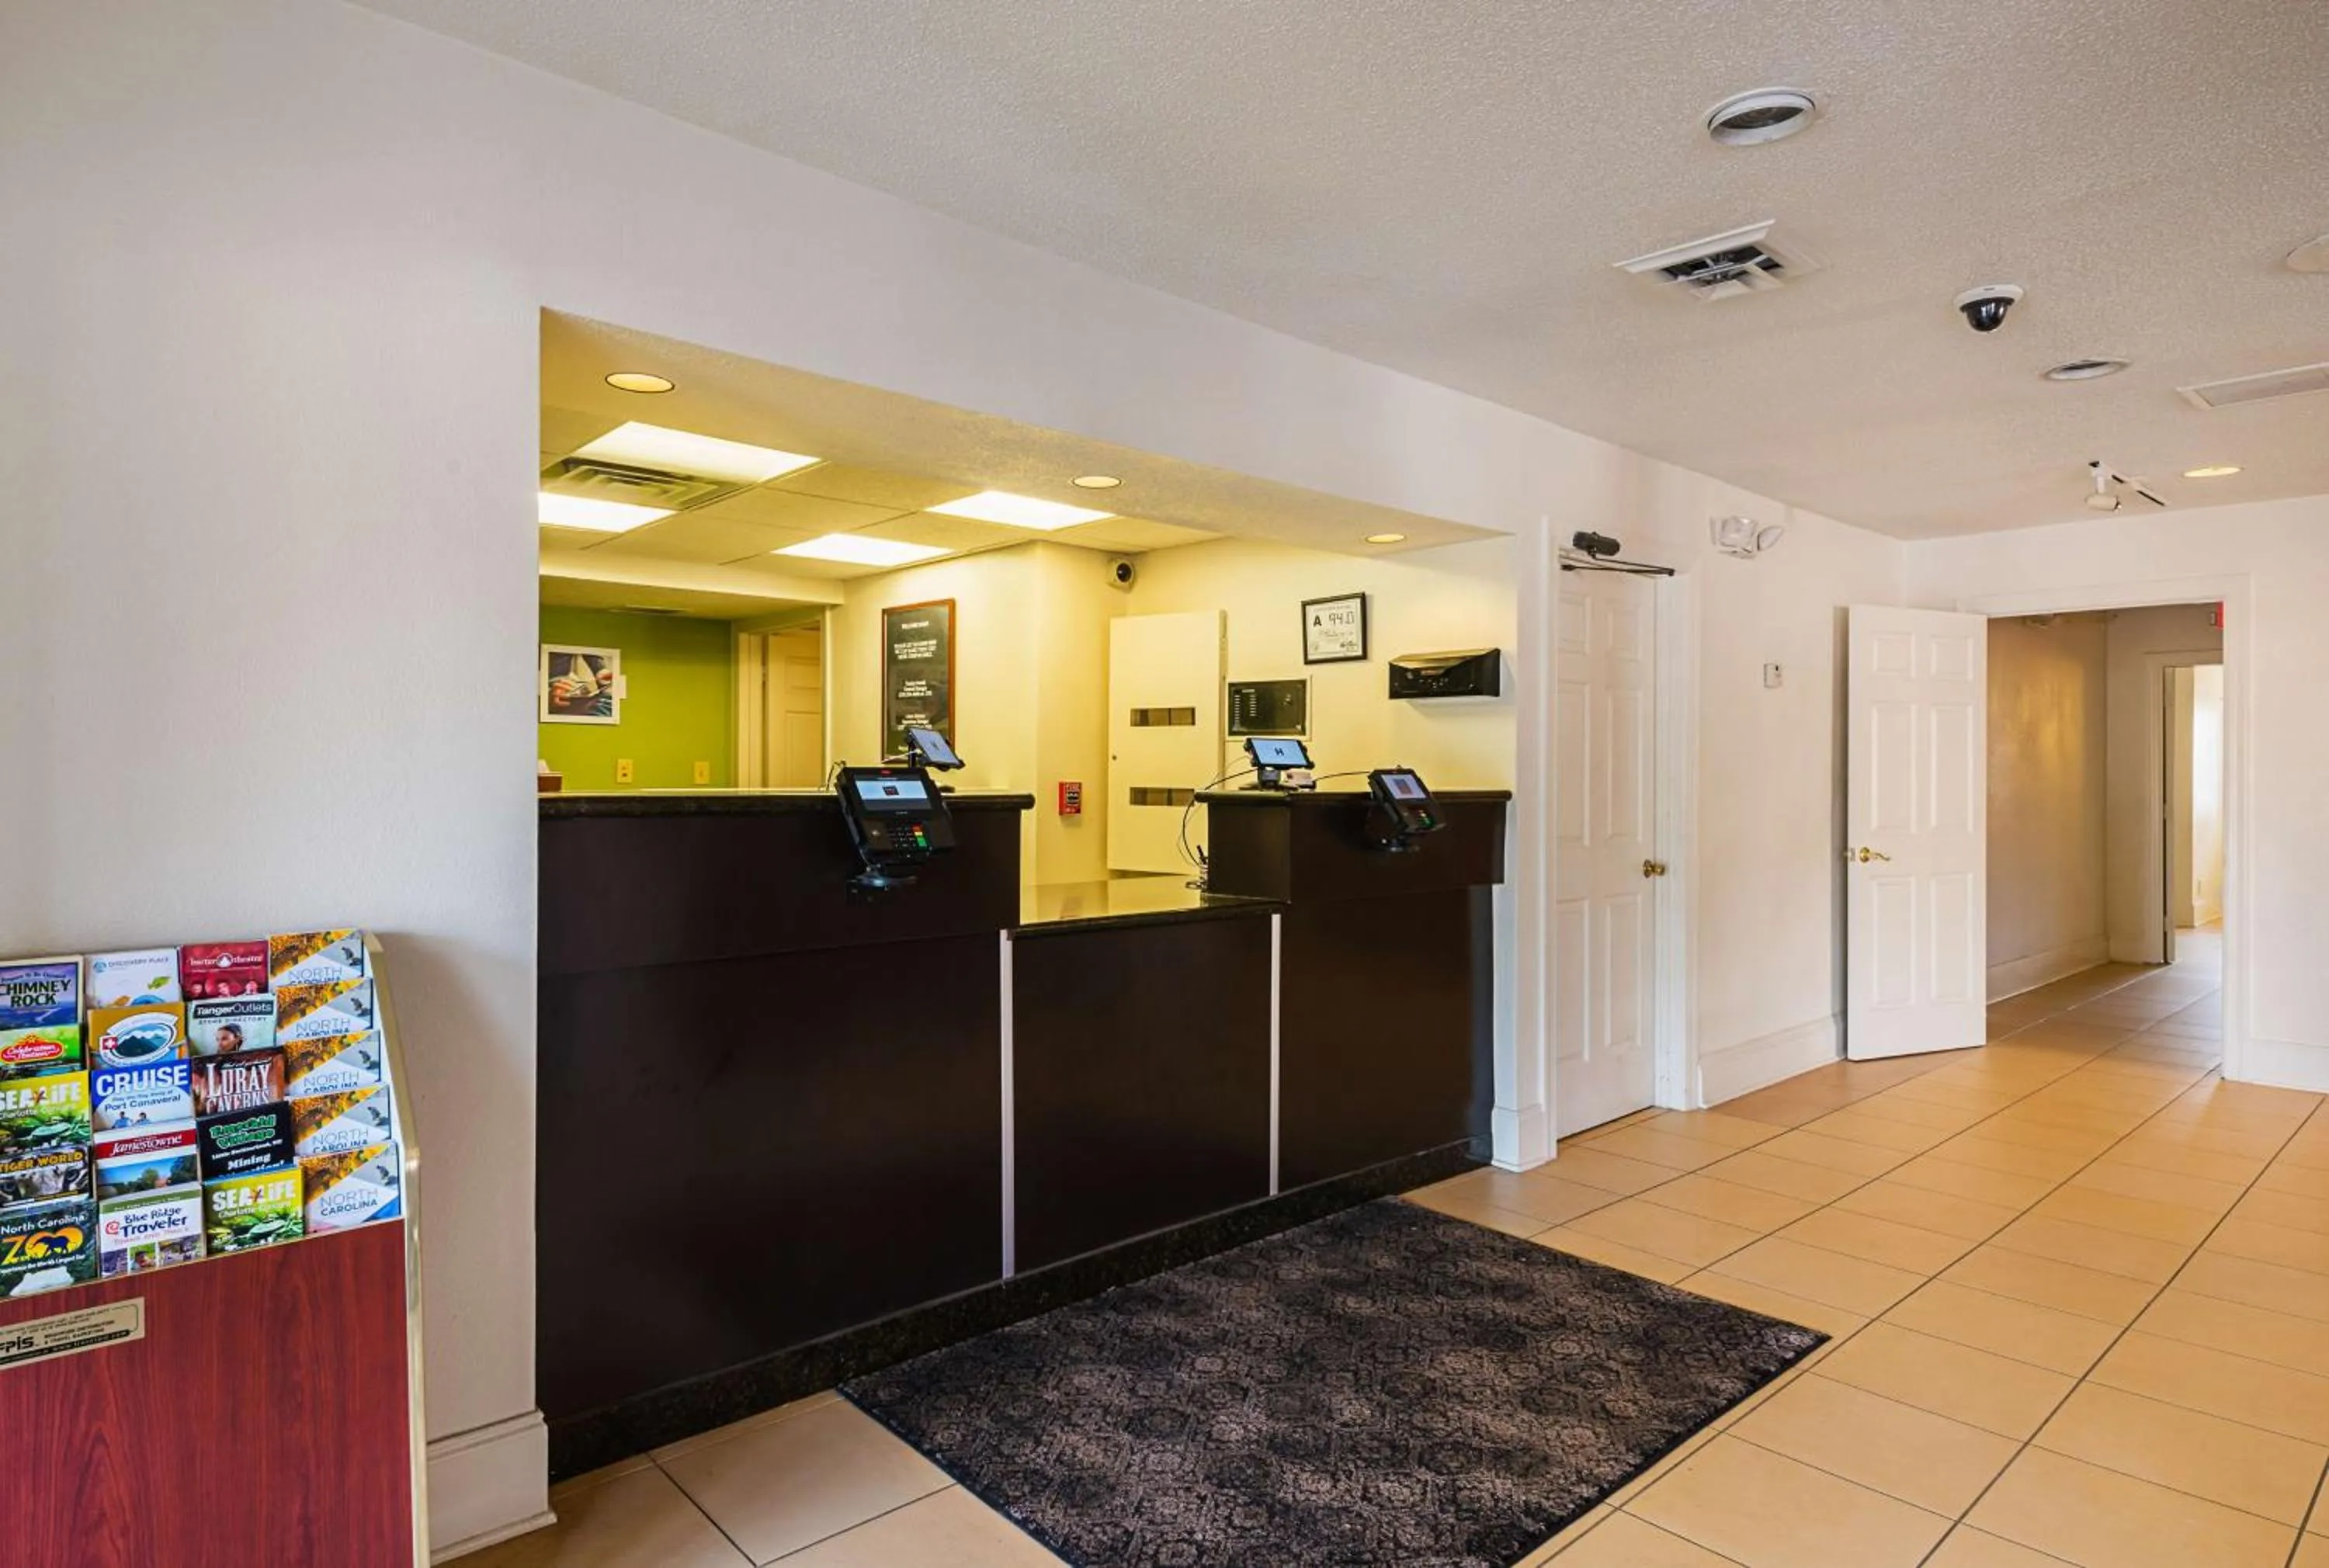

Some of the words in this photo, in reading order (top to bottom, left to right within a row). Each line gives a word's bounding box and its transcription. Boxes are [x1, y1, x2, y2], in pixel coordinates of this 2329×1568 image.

[1313, 615, 1322, 627] A
[288, 966, 342, 980] NORTH
[11, 994, 57, 1008] ROCK
[296, 1018, 349, 1032] NORTH
[95, 1064, 189, 1097] CRUISE
[207, 1063, 270, 1097] LURAY
[304, 1071, 359, 1087] NORTH
[105, 1102, 127, 1112] Port
[130, 1094, 181, 1108] Canaveral
[312, 1128, 369, 1145] NORTH
[38, 1150, 83, 1166] WORLD
[227, 1153, 271, 1171] Mining
[212, 1186, 253, 1212] SEA
[321, 1188, 378, 1207] NORTH
[124, 1213, 148, 1224] Blue
[151, 1207, 182, 1219] Ridge
[321, 1199, 378, 1216] CAROLINA
[1, 1222, 35, 1235] North
[37, 1214, 85, 1228] Carolina
[120, 1216, 188, 1237] Traveler
